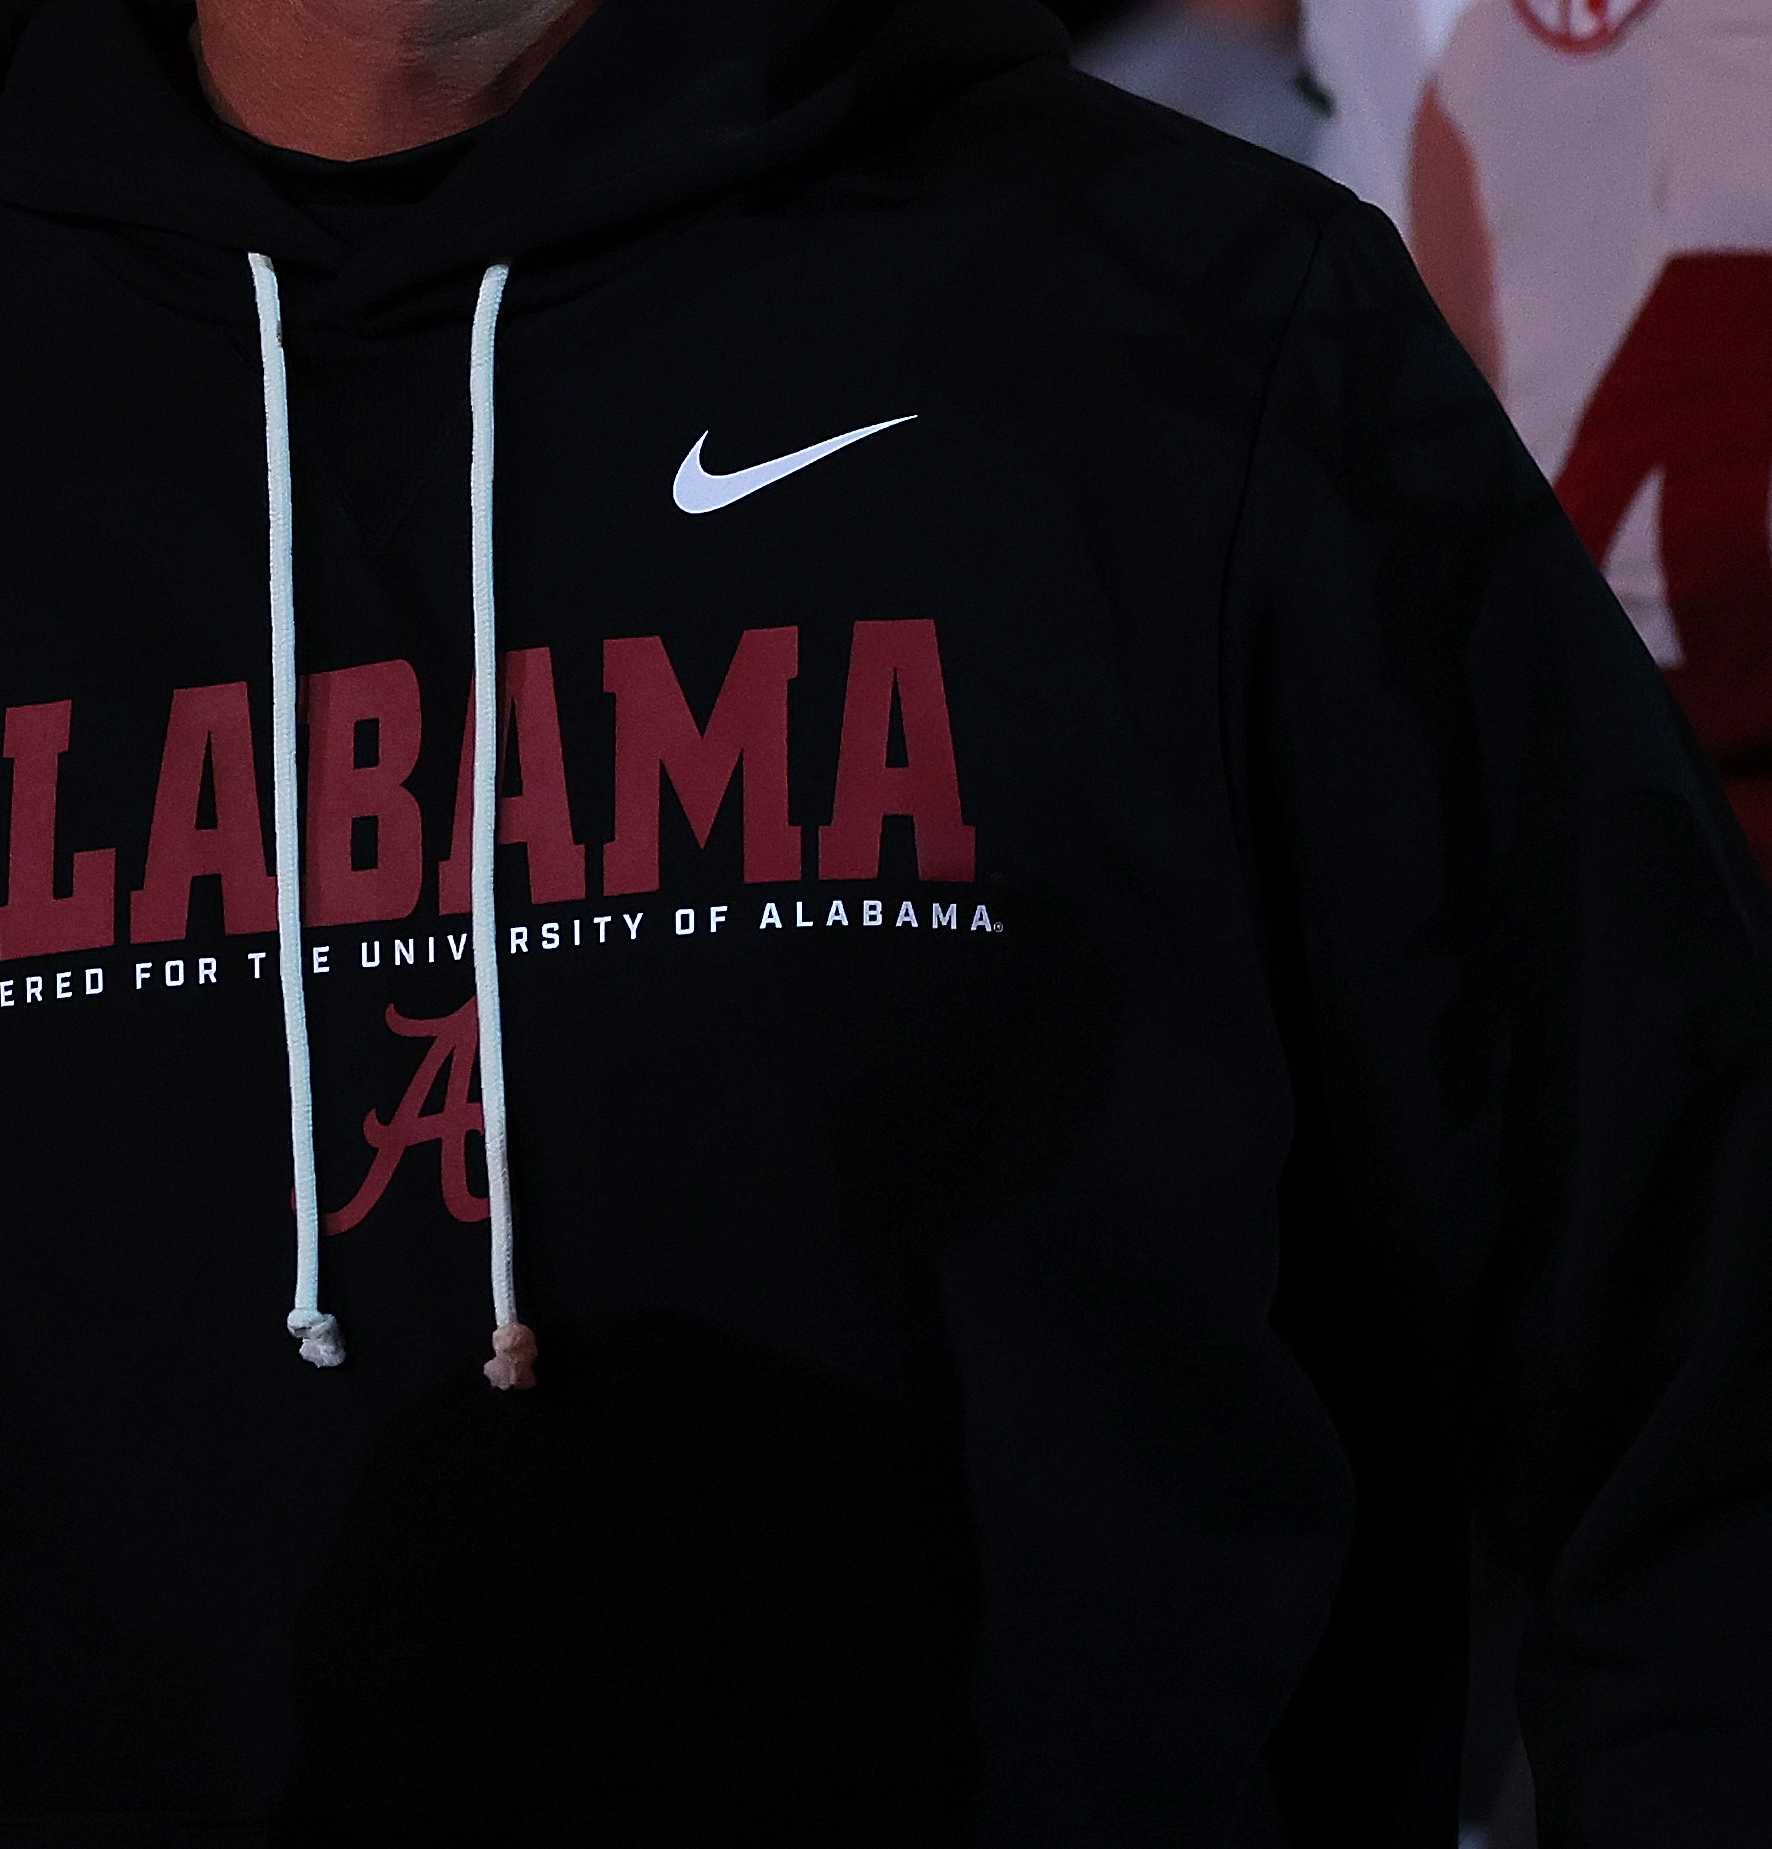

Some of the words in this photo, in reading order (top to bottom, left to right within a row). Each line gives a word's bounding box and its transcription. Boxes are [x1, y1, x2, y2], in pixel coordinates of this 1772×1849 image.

[135, 957, 219, 990] FOR
[248, 946, 330, 980] TE
[360, 912, 645, 969] UNIVRSITY
[674, 904, 729, 937] OF
[289, 993, 492, 1237] A
